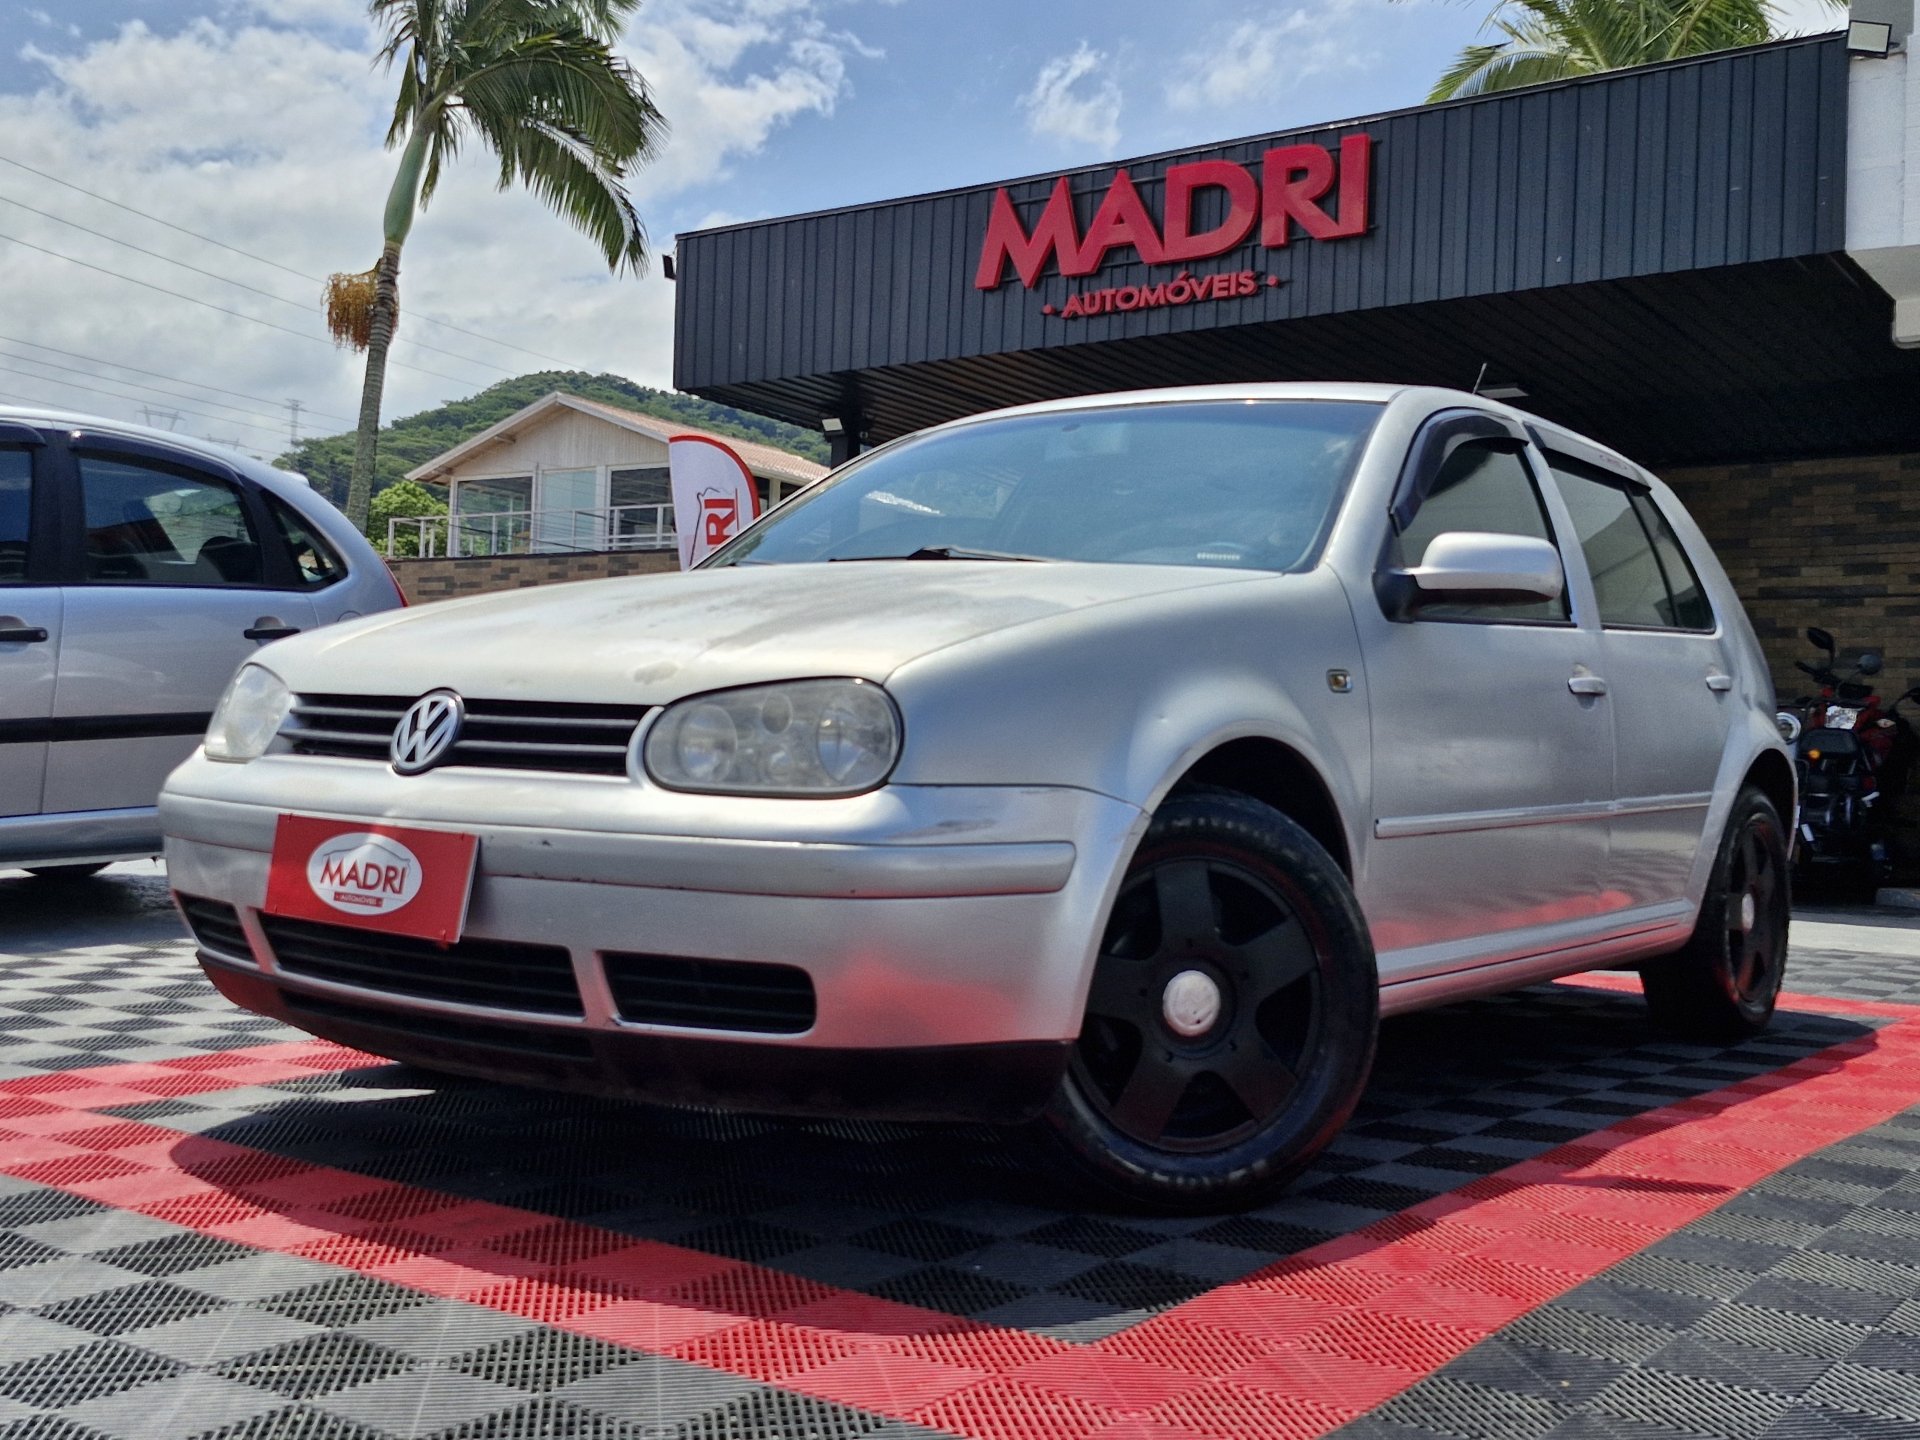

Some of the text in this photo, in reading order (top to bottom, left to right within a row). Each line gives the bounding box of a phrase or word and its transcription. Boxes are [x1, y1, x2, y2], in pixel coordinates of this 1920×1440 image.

[974, 133, 1371, 289] MADRI
[1062, 270, 1258, 319] AUTOMÓVEIS
[704, 499, 735, 546] RI
[320, 856, 408, 894] MADRI
